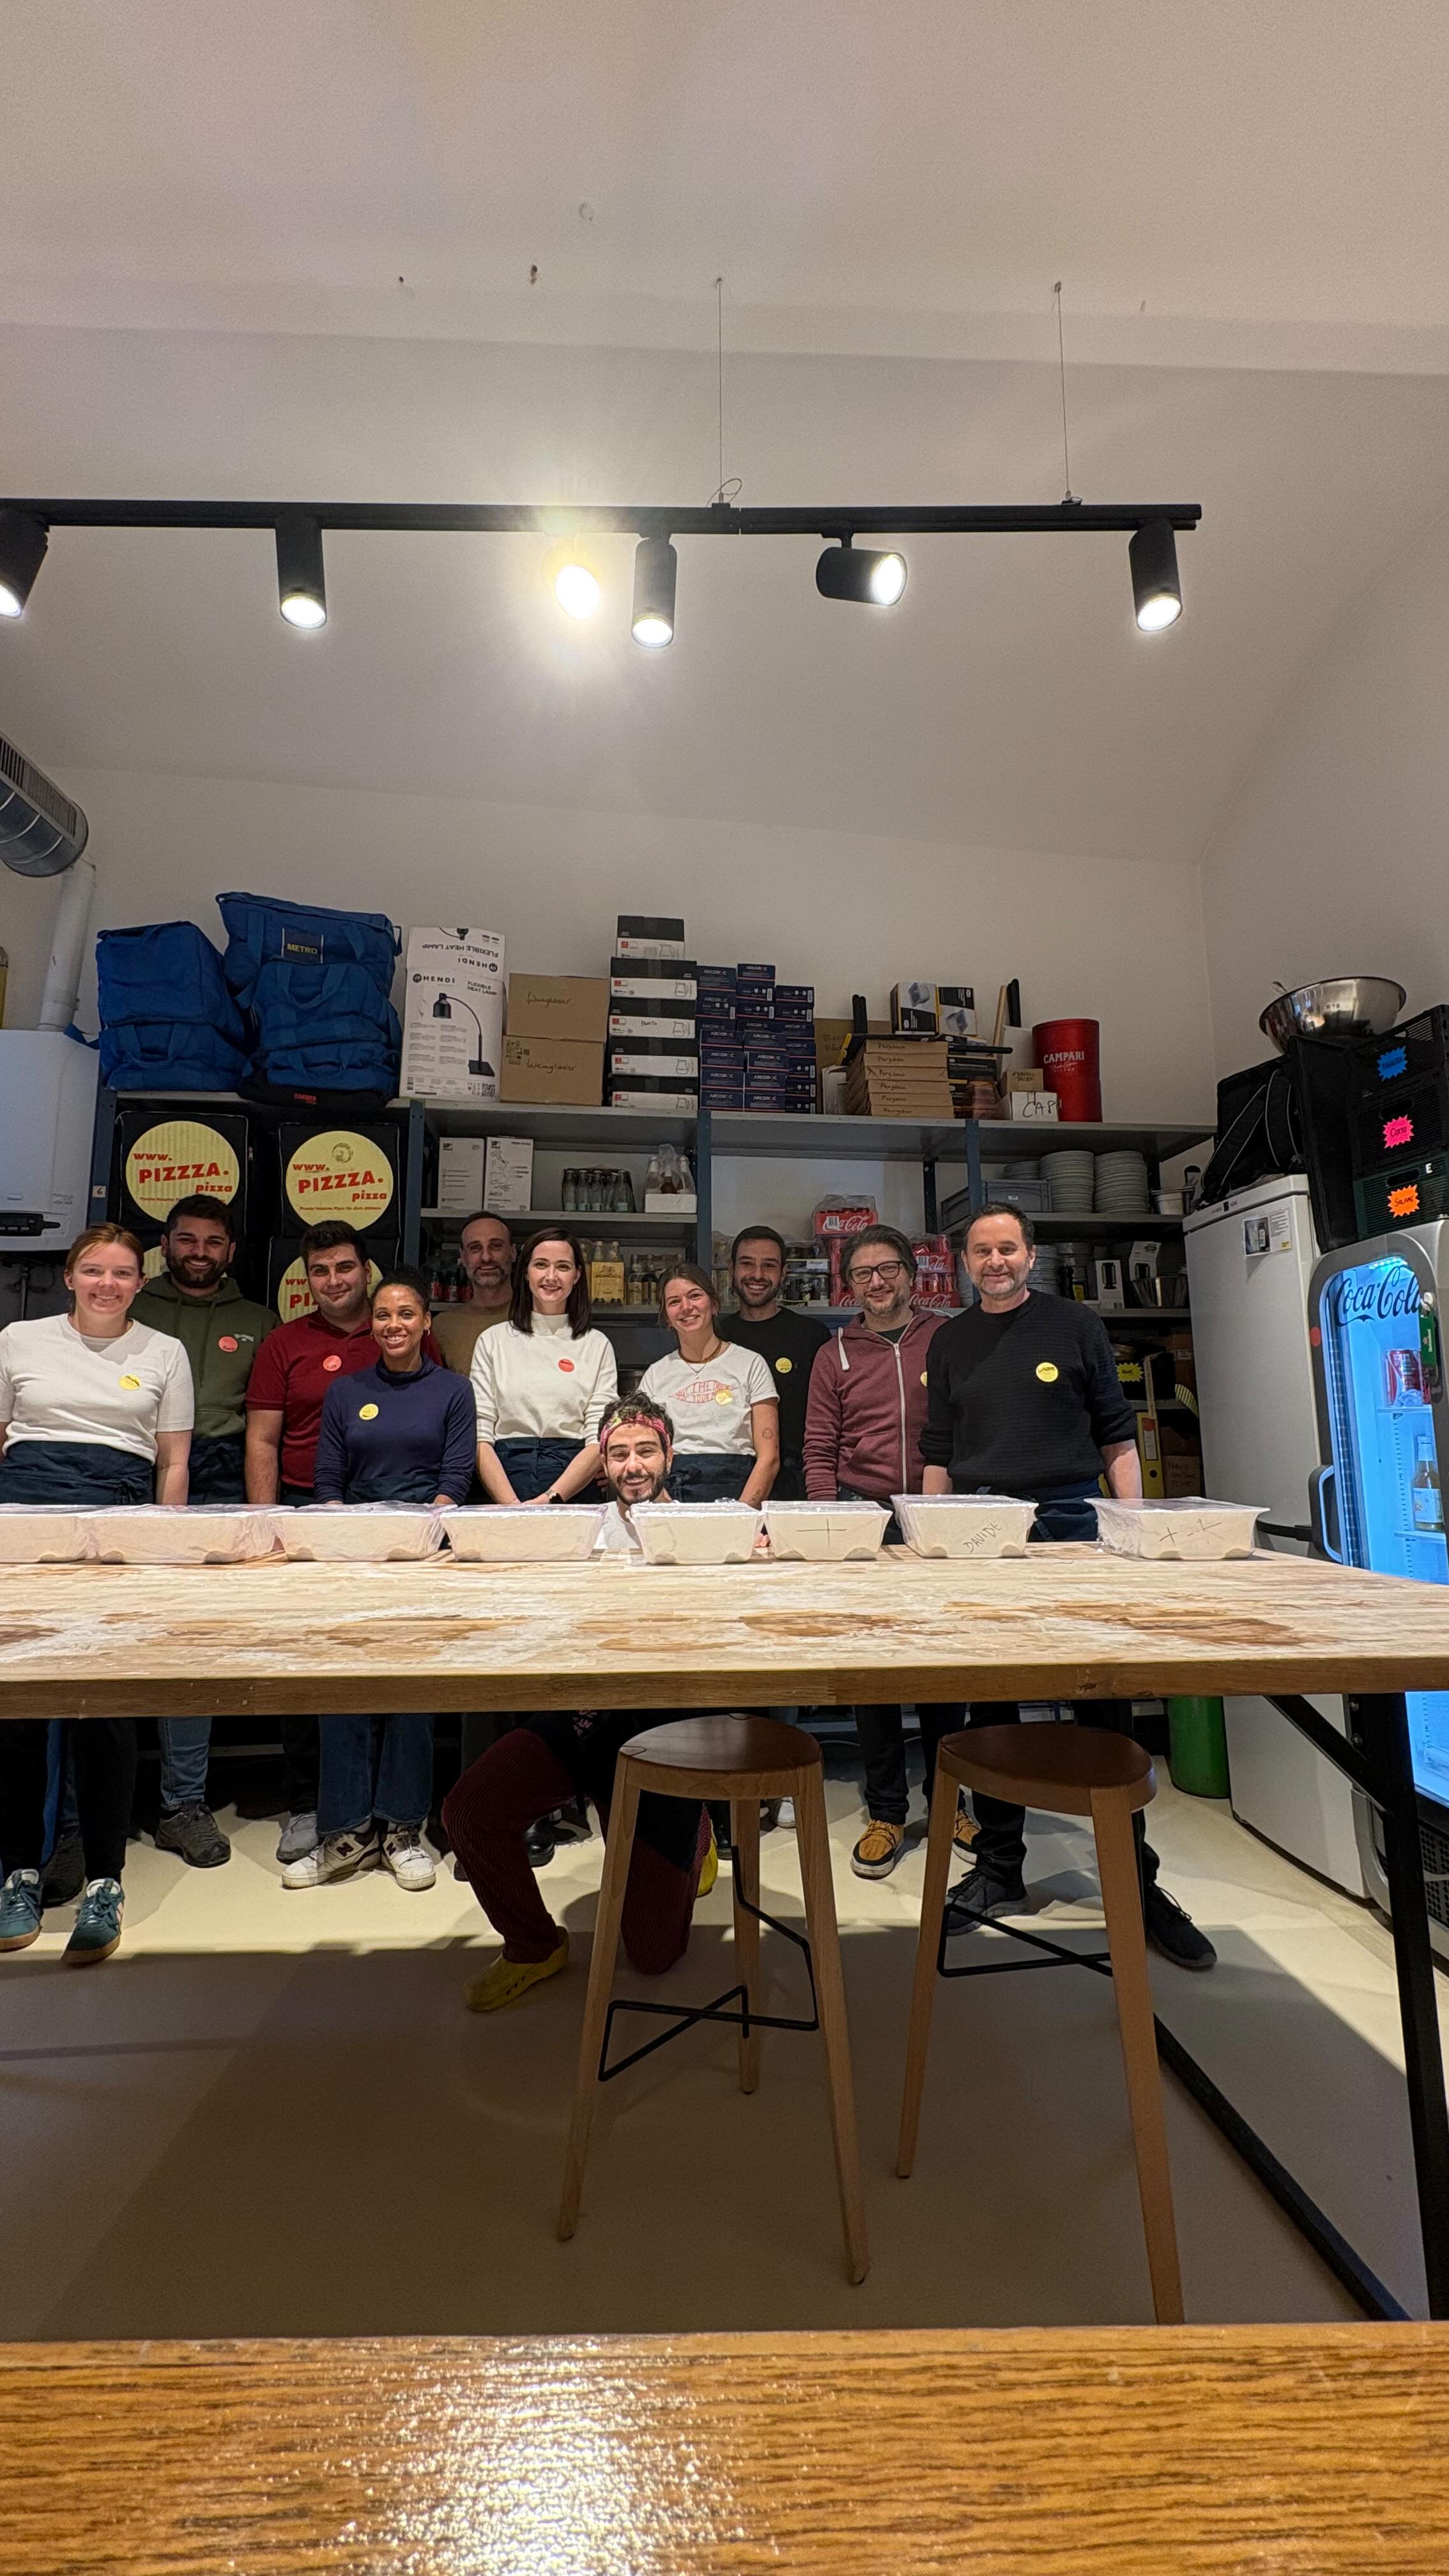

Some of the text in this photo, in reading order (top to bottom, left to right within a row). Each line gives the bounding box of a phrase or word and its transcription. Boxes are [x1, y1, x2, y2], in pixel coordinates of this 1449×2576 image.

[286, 943, 318, 954] METRO
[466, 945, 499, 958] FLEXIBLE
[458, 958, 487, 968] HENDI
[467, 981, 491, 990] FLEXIBLE
[1043, 1051, 1085, 1064] CAMPARI
[133, 1153, 172, 1161] www.
[139, 1162, 229, 1183] PIZZZA.
[195, 1182, 233, 1193] pizza
[298, 1170, 383, 1193] PIZZZA.
[352, 1190, 387, 1202] pizza
[963, 1521, 1002, 1553] DAVIDE
